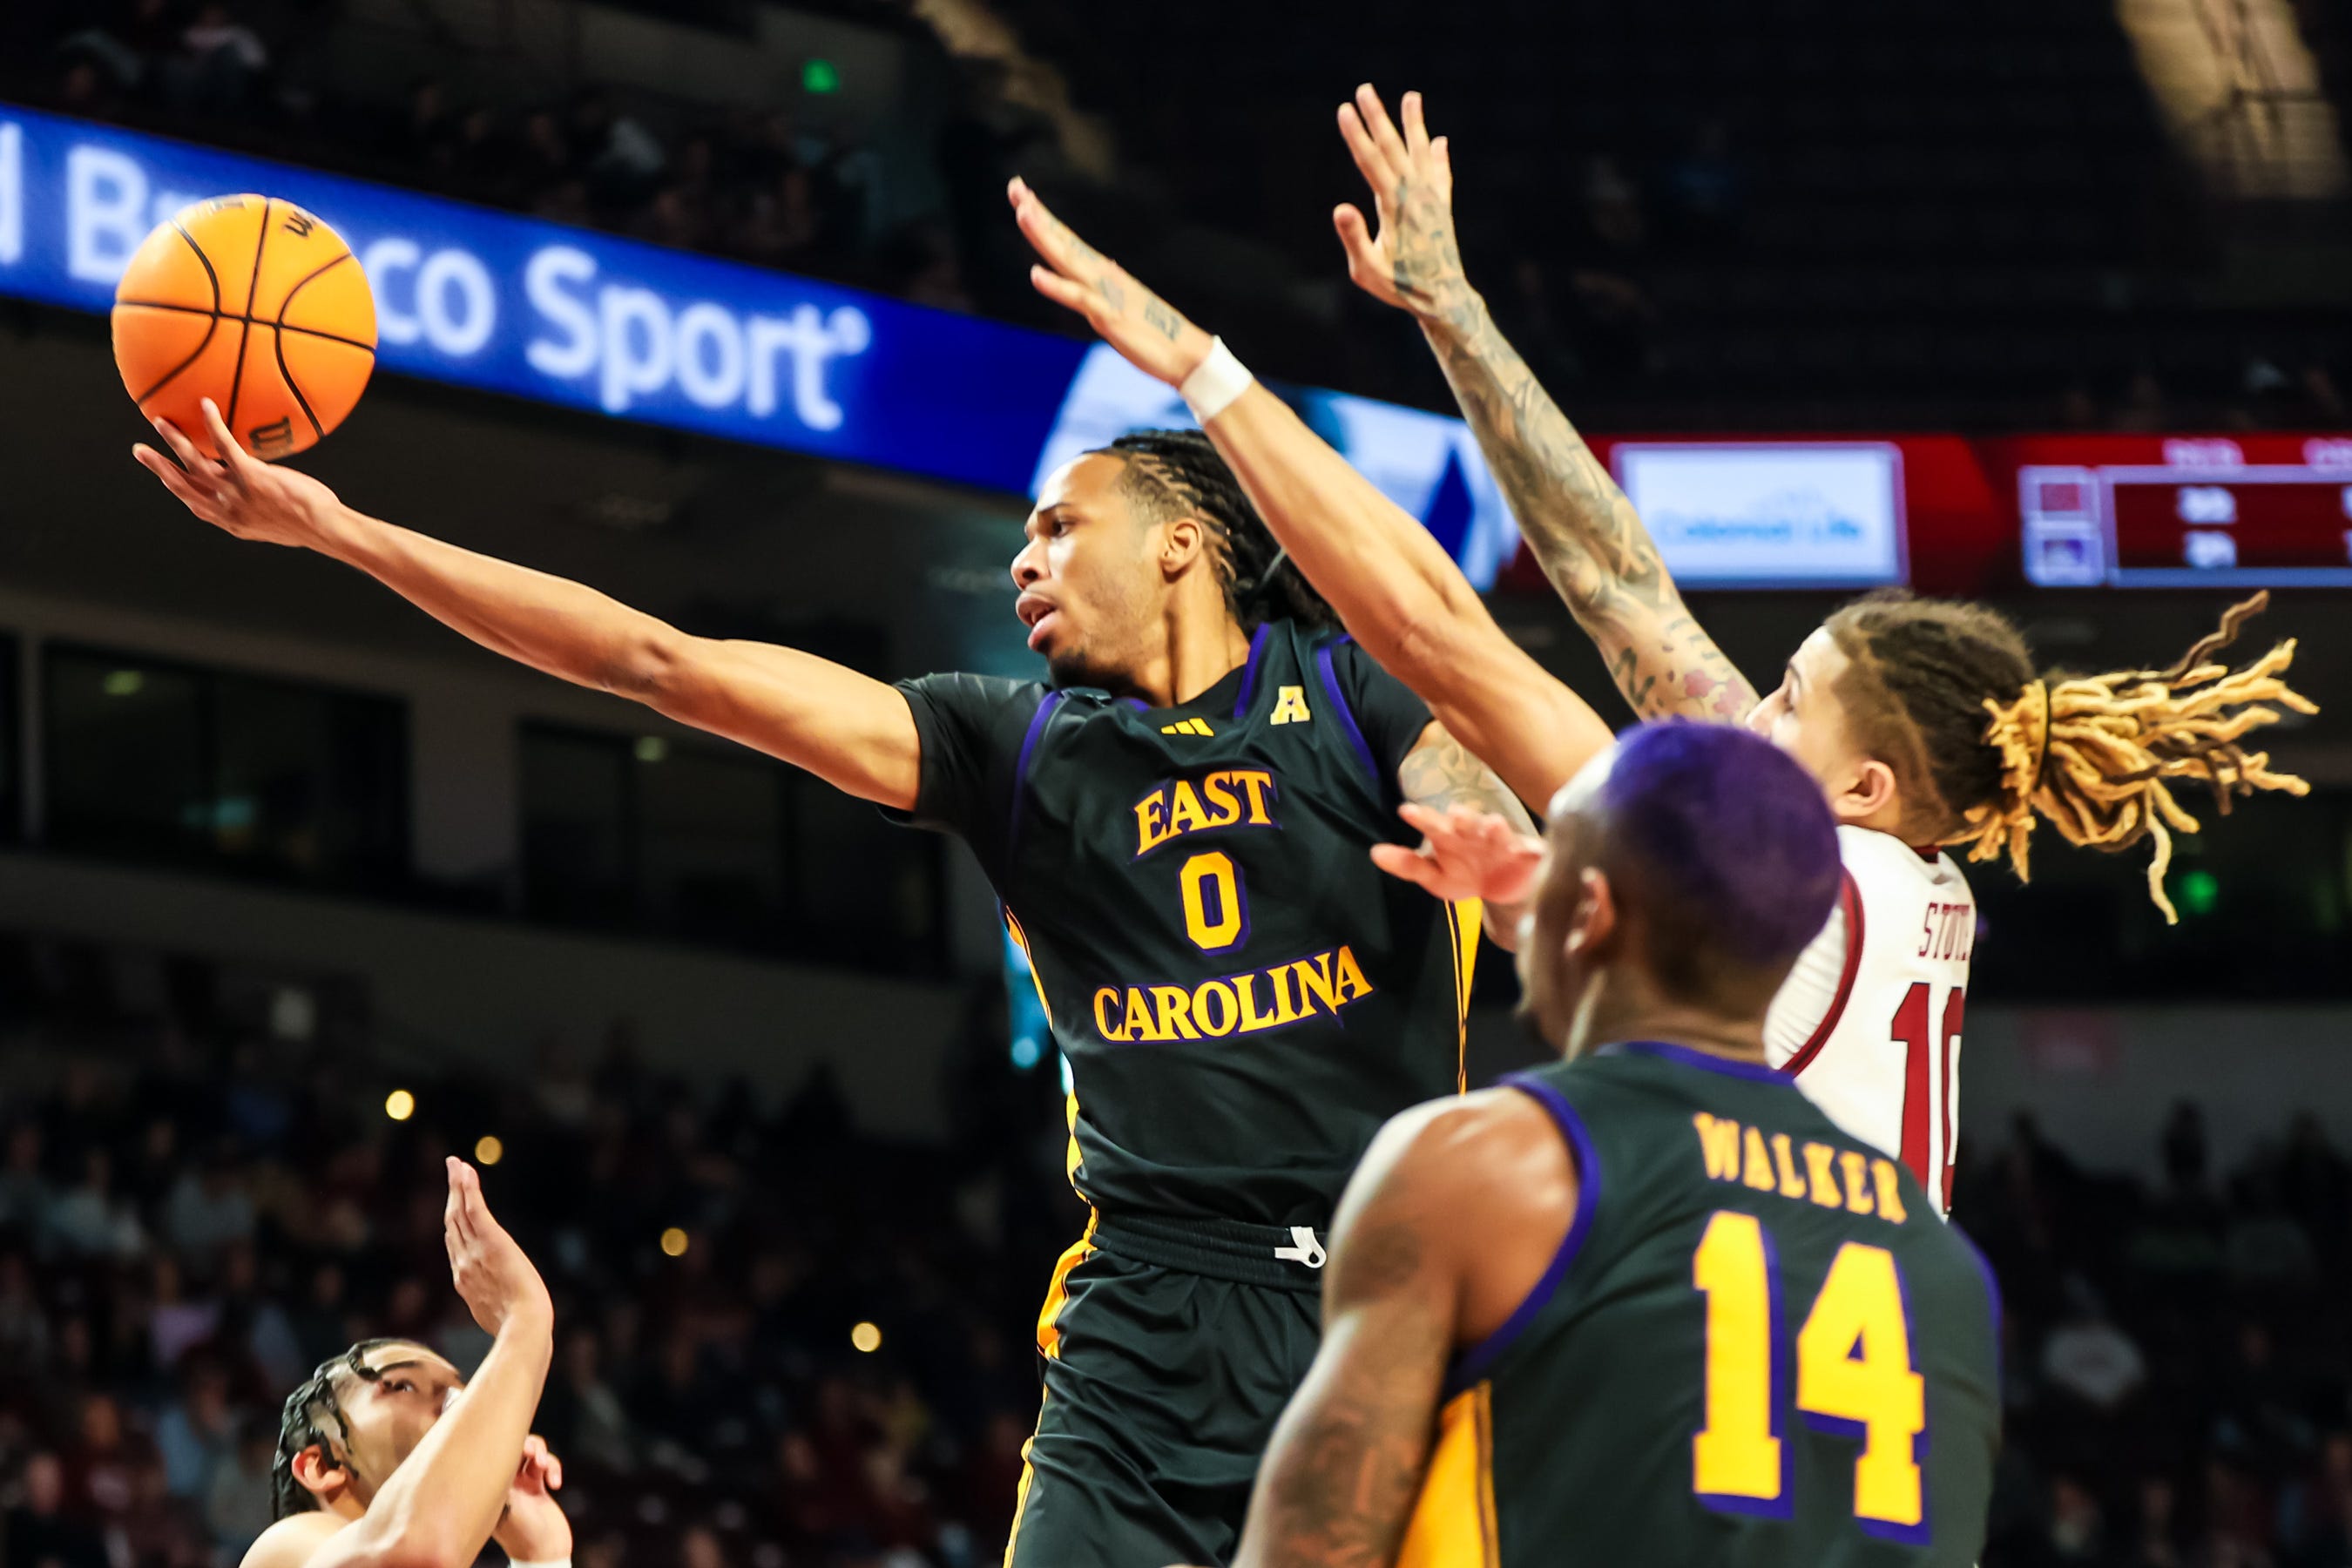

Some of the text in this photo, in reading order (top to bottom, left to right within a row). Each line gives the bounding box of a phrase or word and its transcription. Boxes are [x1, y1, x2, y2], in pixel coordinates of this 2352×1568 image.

[1134, 769, 1274, 856] EAST
[1179, 850, 1246, 953] 0
[1093, 944, 1375, 1043] CAROLINA
[1693, 1112, 1907, 1224] WALKER
[1693, 1209, 1927, 1542] 14
